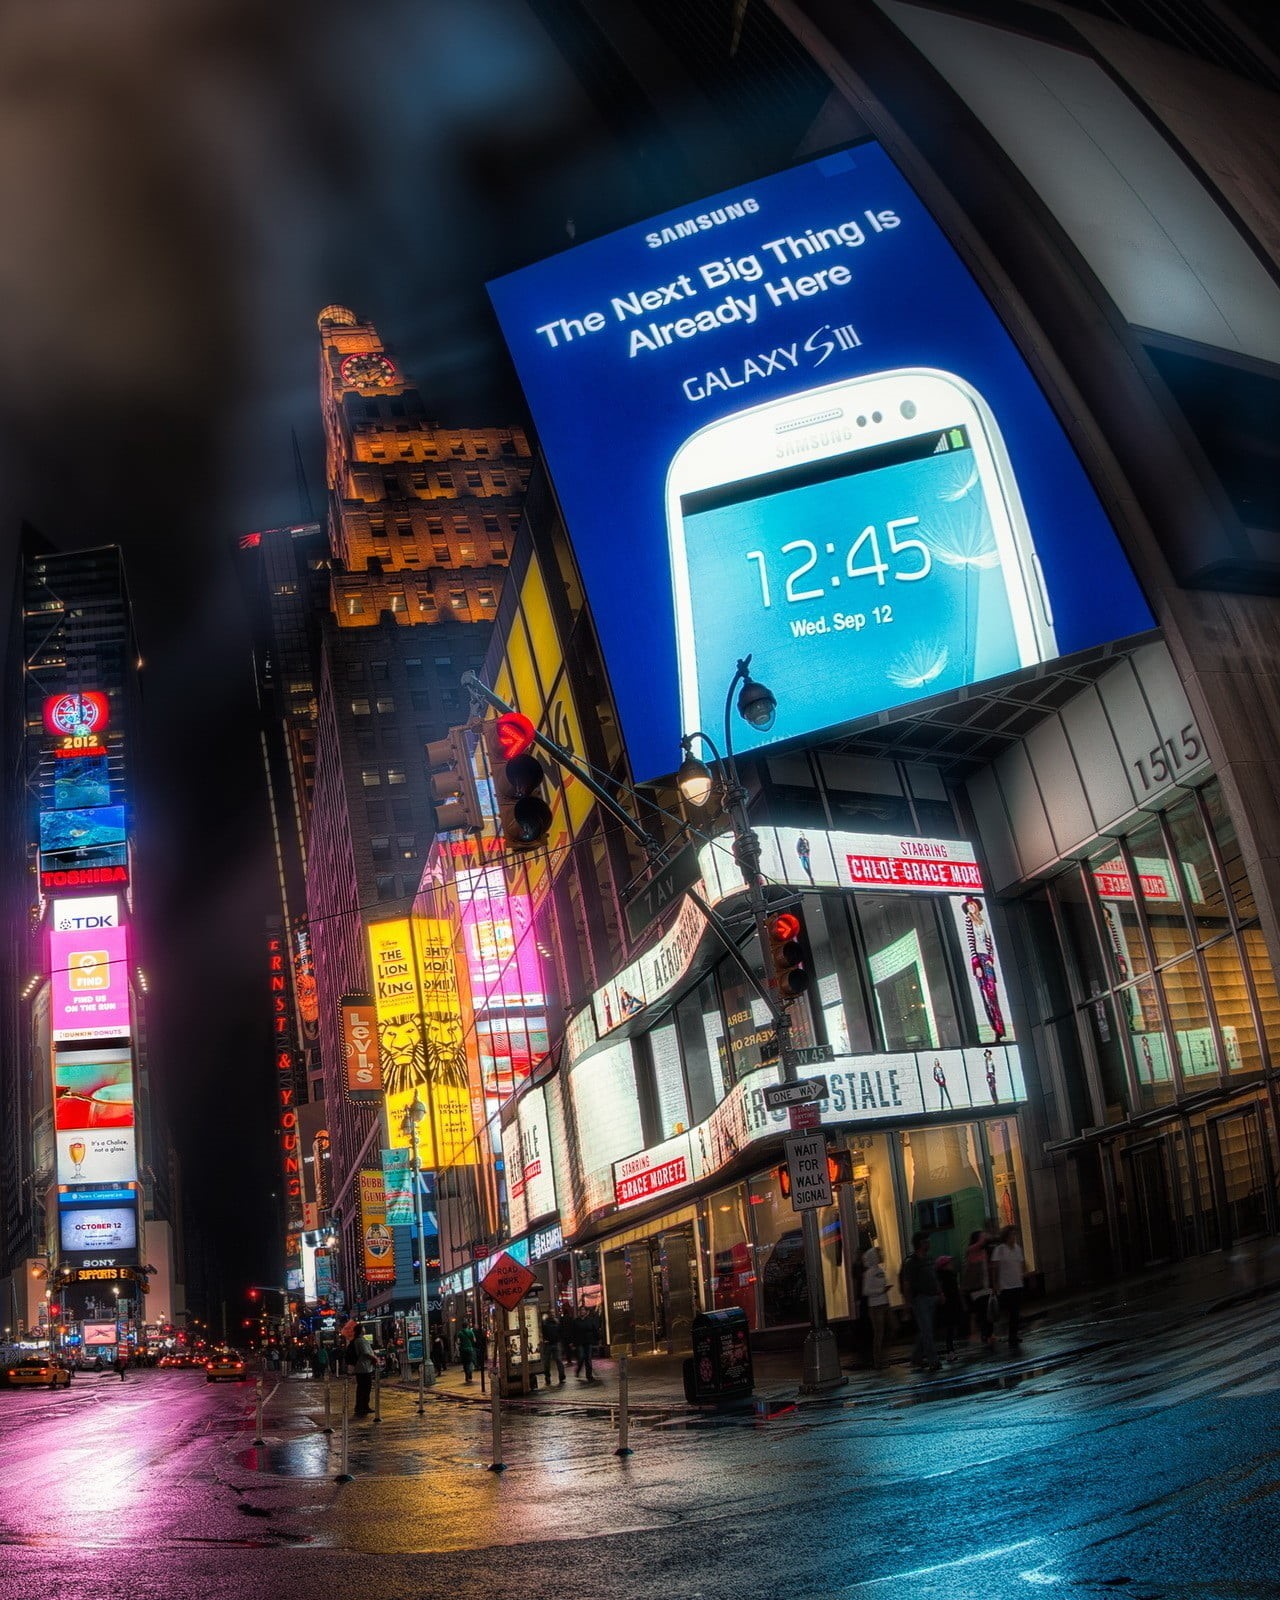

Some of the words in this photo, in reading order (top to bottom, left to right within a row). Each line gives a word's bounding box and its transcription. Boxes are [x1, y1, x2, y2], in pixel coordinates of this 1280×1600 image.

[645, 198, 760, 250] SAMSUNG
[536, 311, 606, 349] The
[611, 275, 697, 322] Next
[698, 254, 763, 290] Big
[761, 220, 866, 265] Thing
[864, 208, 902, 233] Is
[628, 294, 757, 359] Already
[764, 265, 853, 307] Here
[682, 343, 799, 402] GALAXY
[775, 428, 853, 460] SAMSUNG
[746, 515, 932, 608] 12:45
[790, 616, 831, 638] Wed.
[833, 612, 866, 632] Sep
[872, 605, 893, 624] 12
[63, 735, 98, 749] 2012
[1134, 723, 1201, 790] 1515
[900, 841, 948, 858] STARRING
[41, 867, 127, 886] TOSHIBA
[852, 858, 898, 882] CHLOË
[903, 862, 948, 883] GRACE
[72, 915, 113, 928] TDK
[379, 949, 402, 961] THE
[378, 963, 408, 979] LION
[269, 940, 286, 1032] ERNST
[378, 981, 414, 999] KING
[796, 1050, 808, 1064] W
[773, 1090, 792, 1104] ONE
[799, 1085, 819, 1099] WAY
[795, 1143, 819, 1157] WAIT
[621, 1155, 650, 1177] STARRING
[799, 1159, 819, 1172] FOR
[361, 1175, 385, 1189] BUBB
[622, 1179, 649, 1200] GRACE
[650, 1162, 686, 1190] MORETZ
[796, 1174, 825, 1188] WALK
[796, 1190, 828, 1204] SIGNAL
[75, 1223, 112, 1231] OCTOBER
[82, 1259, 116, 1267] SONY
[497, 1266, 518, 1275] ROAD
[496, 1287, 523, 1297] AHEAD
